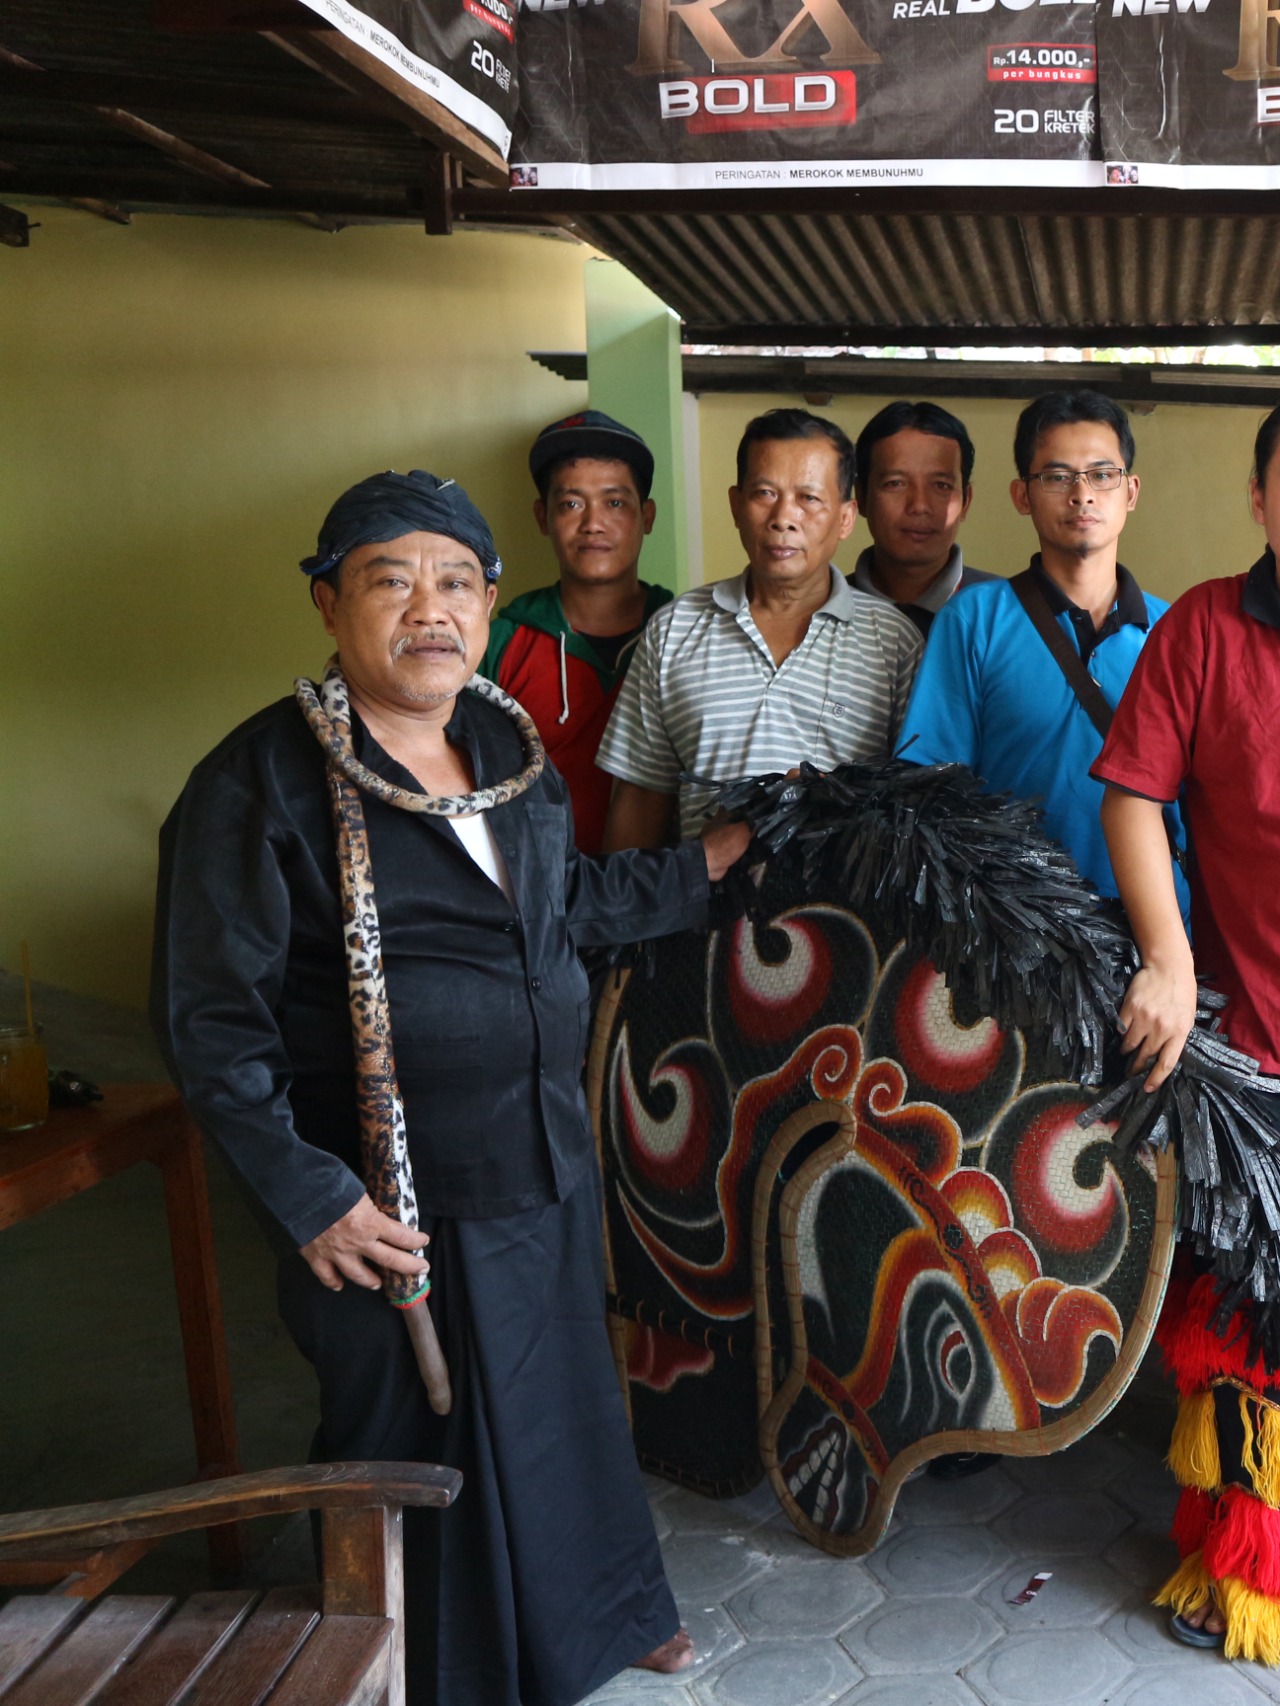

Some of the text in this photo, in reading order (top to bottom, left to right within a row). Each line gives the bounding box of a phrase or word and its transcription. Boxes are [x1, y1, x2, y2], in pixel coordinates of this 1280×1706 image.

[892, 0, 950, 19] REAL
[370, 30, 400, 61] MEROKOK
[471, 40, 495, 78] 20
[1003, 70, 1081, 80] per bungkus
[659, 75, 836, 119] BOLD
[994, 109, 1095, 133] 20 FILTER
[1044, 122, 1095, 134] KRETEK
[715, 170, 781, 180] PERINGATAN
[790, 169, 844, 179] MEROKOK
[847, 168, 924, 178] MEMBUNUHMU
